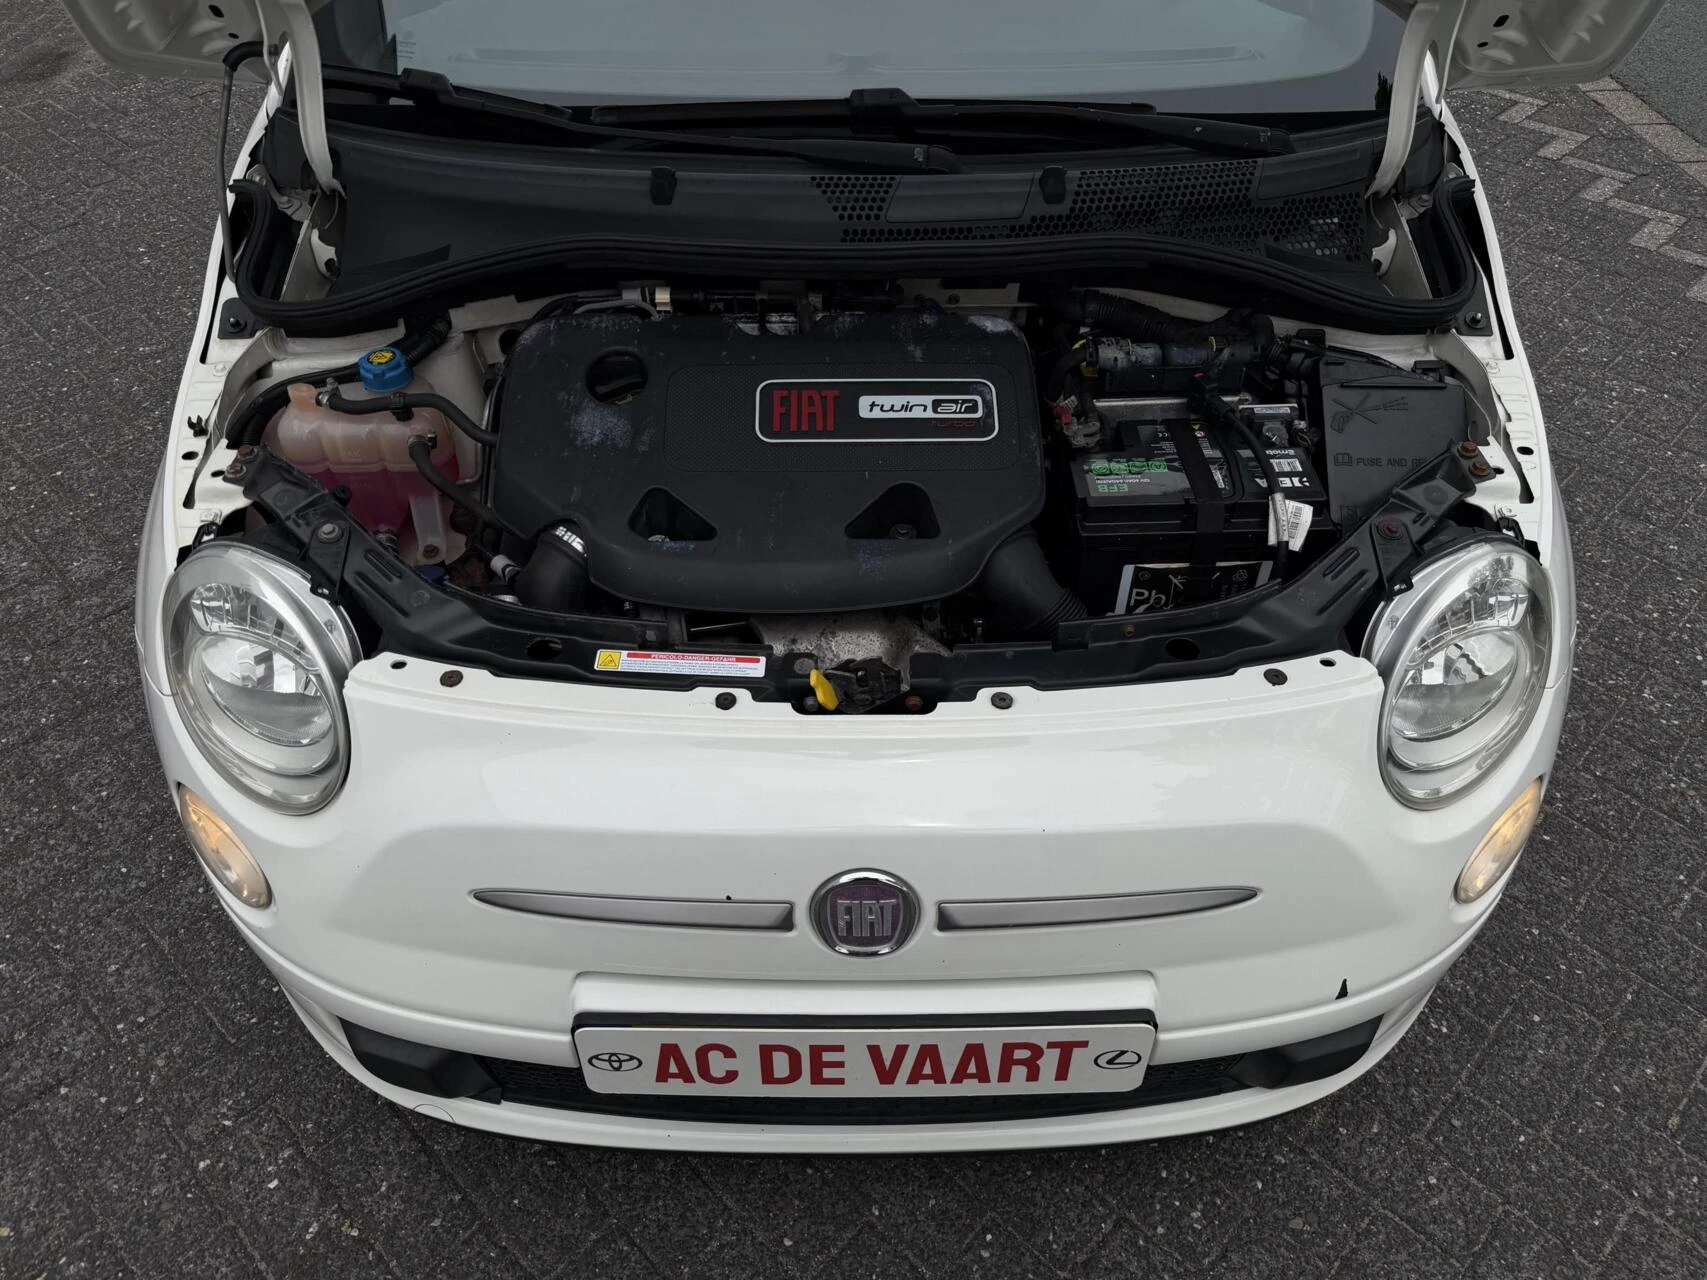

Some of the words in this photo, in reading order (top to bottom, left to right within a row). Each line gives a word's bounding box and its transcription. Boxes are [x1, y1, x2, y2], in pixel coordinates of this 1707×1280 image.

[772, 390, 840, 432] FIAT
[868, 400, 928, 414] twin
[937, 400, 976, 414] air
[1355, 457, 1383, 467] FUSE
[1387, 457, 1408, 467] AND
[1097, 484, 1129, 493] EFB
[1130, 588, 1166, 607] Pb
[837, 899, 897, 937] FIAT
[655, 1043, 739, 1085] AC
[759, 1043, 846, 1085] DE
[866, 1040, 1090, 1084] VAART
